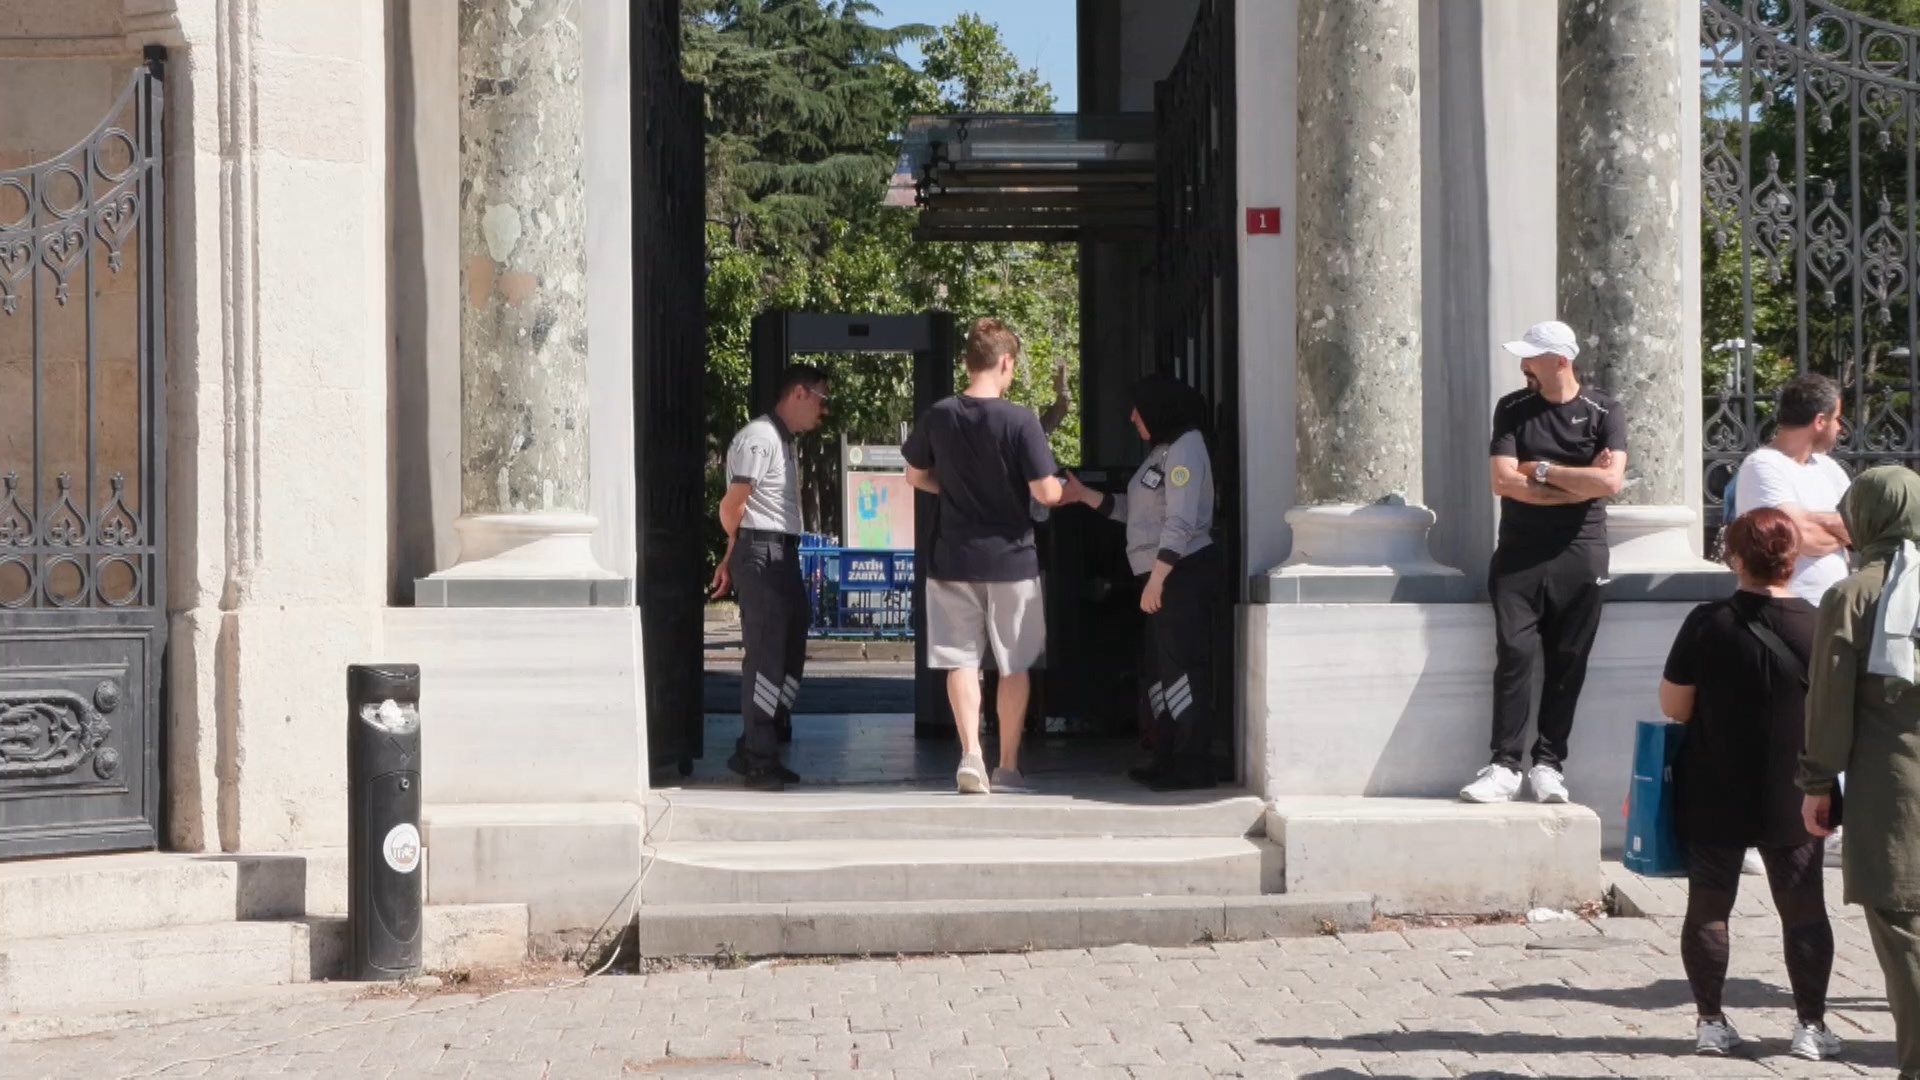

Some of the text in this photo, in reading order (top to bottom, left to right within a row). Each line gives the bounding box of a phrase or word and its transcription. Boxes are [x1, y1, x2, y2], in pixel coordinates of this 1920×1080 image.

[1259, 213, 1267, 228] 1
[852, 559, 884, 571] FATİH
[848, 571, 886, 581] ZABITA
